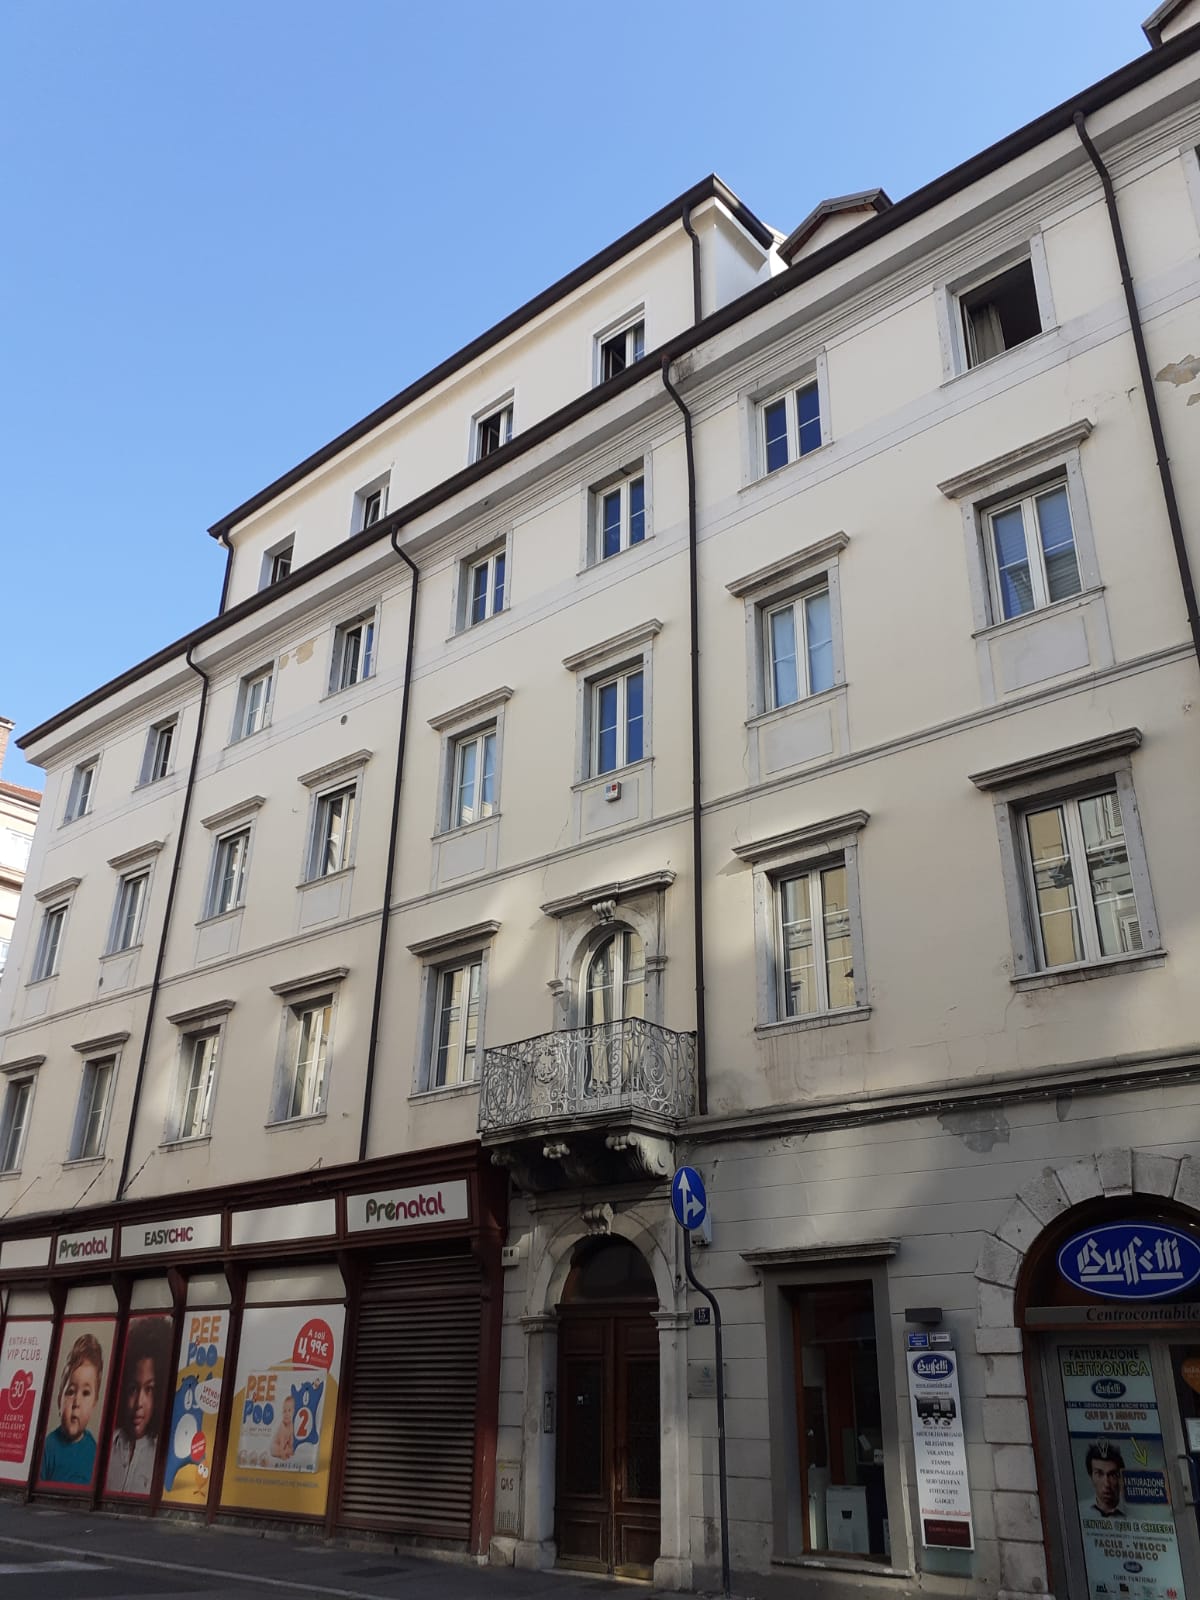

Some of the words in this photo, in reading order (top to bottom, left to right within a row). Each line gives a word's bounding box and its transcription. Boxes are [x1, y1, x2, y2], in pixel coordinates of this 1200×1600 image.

[144, 1227, 193, 1246] EASYCHIC
[1077, 1236, 1182, 1285] Buffetti
[190, 1316, 221, 1344] PEE
[187, 1343, 218, 1367] POO
[1069, 1350, 1139, 1360] FATTURAZIONE
[1063, 1360, 1150, 1376] ELETTRONICA
[246, 1375, 277, 1402] PEE
[243, 1400, 274, 1425] POO
[296, 1408, 309, 1437] 2
